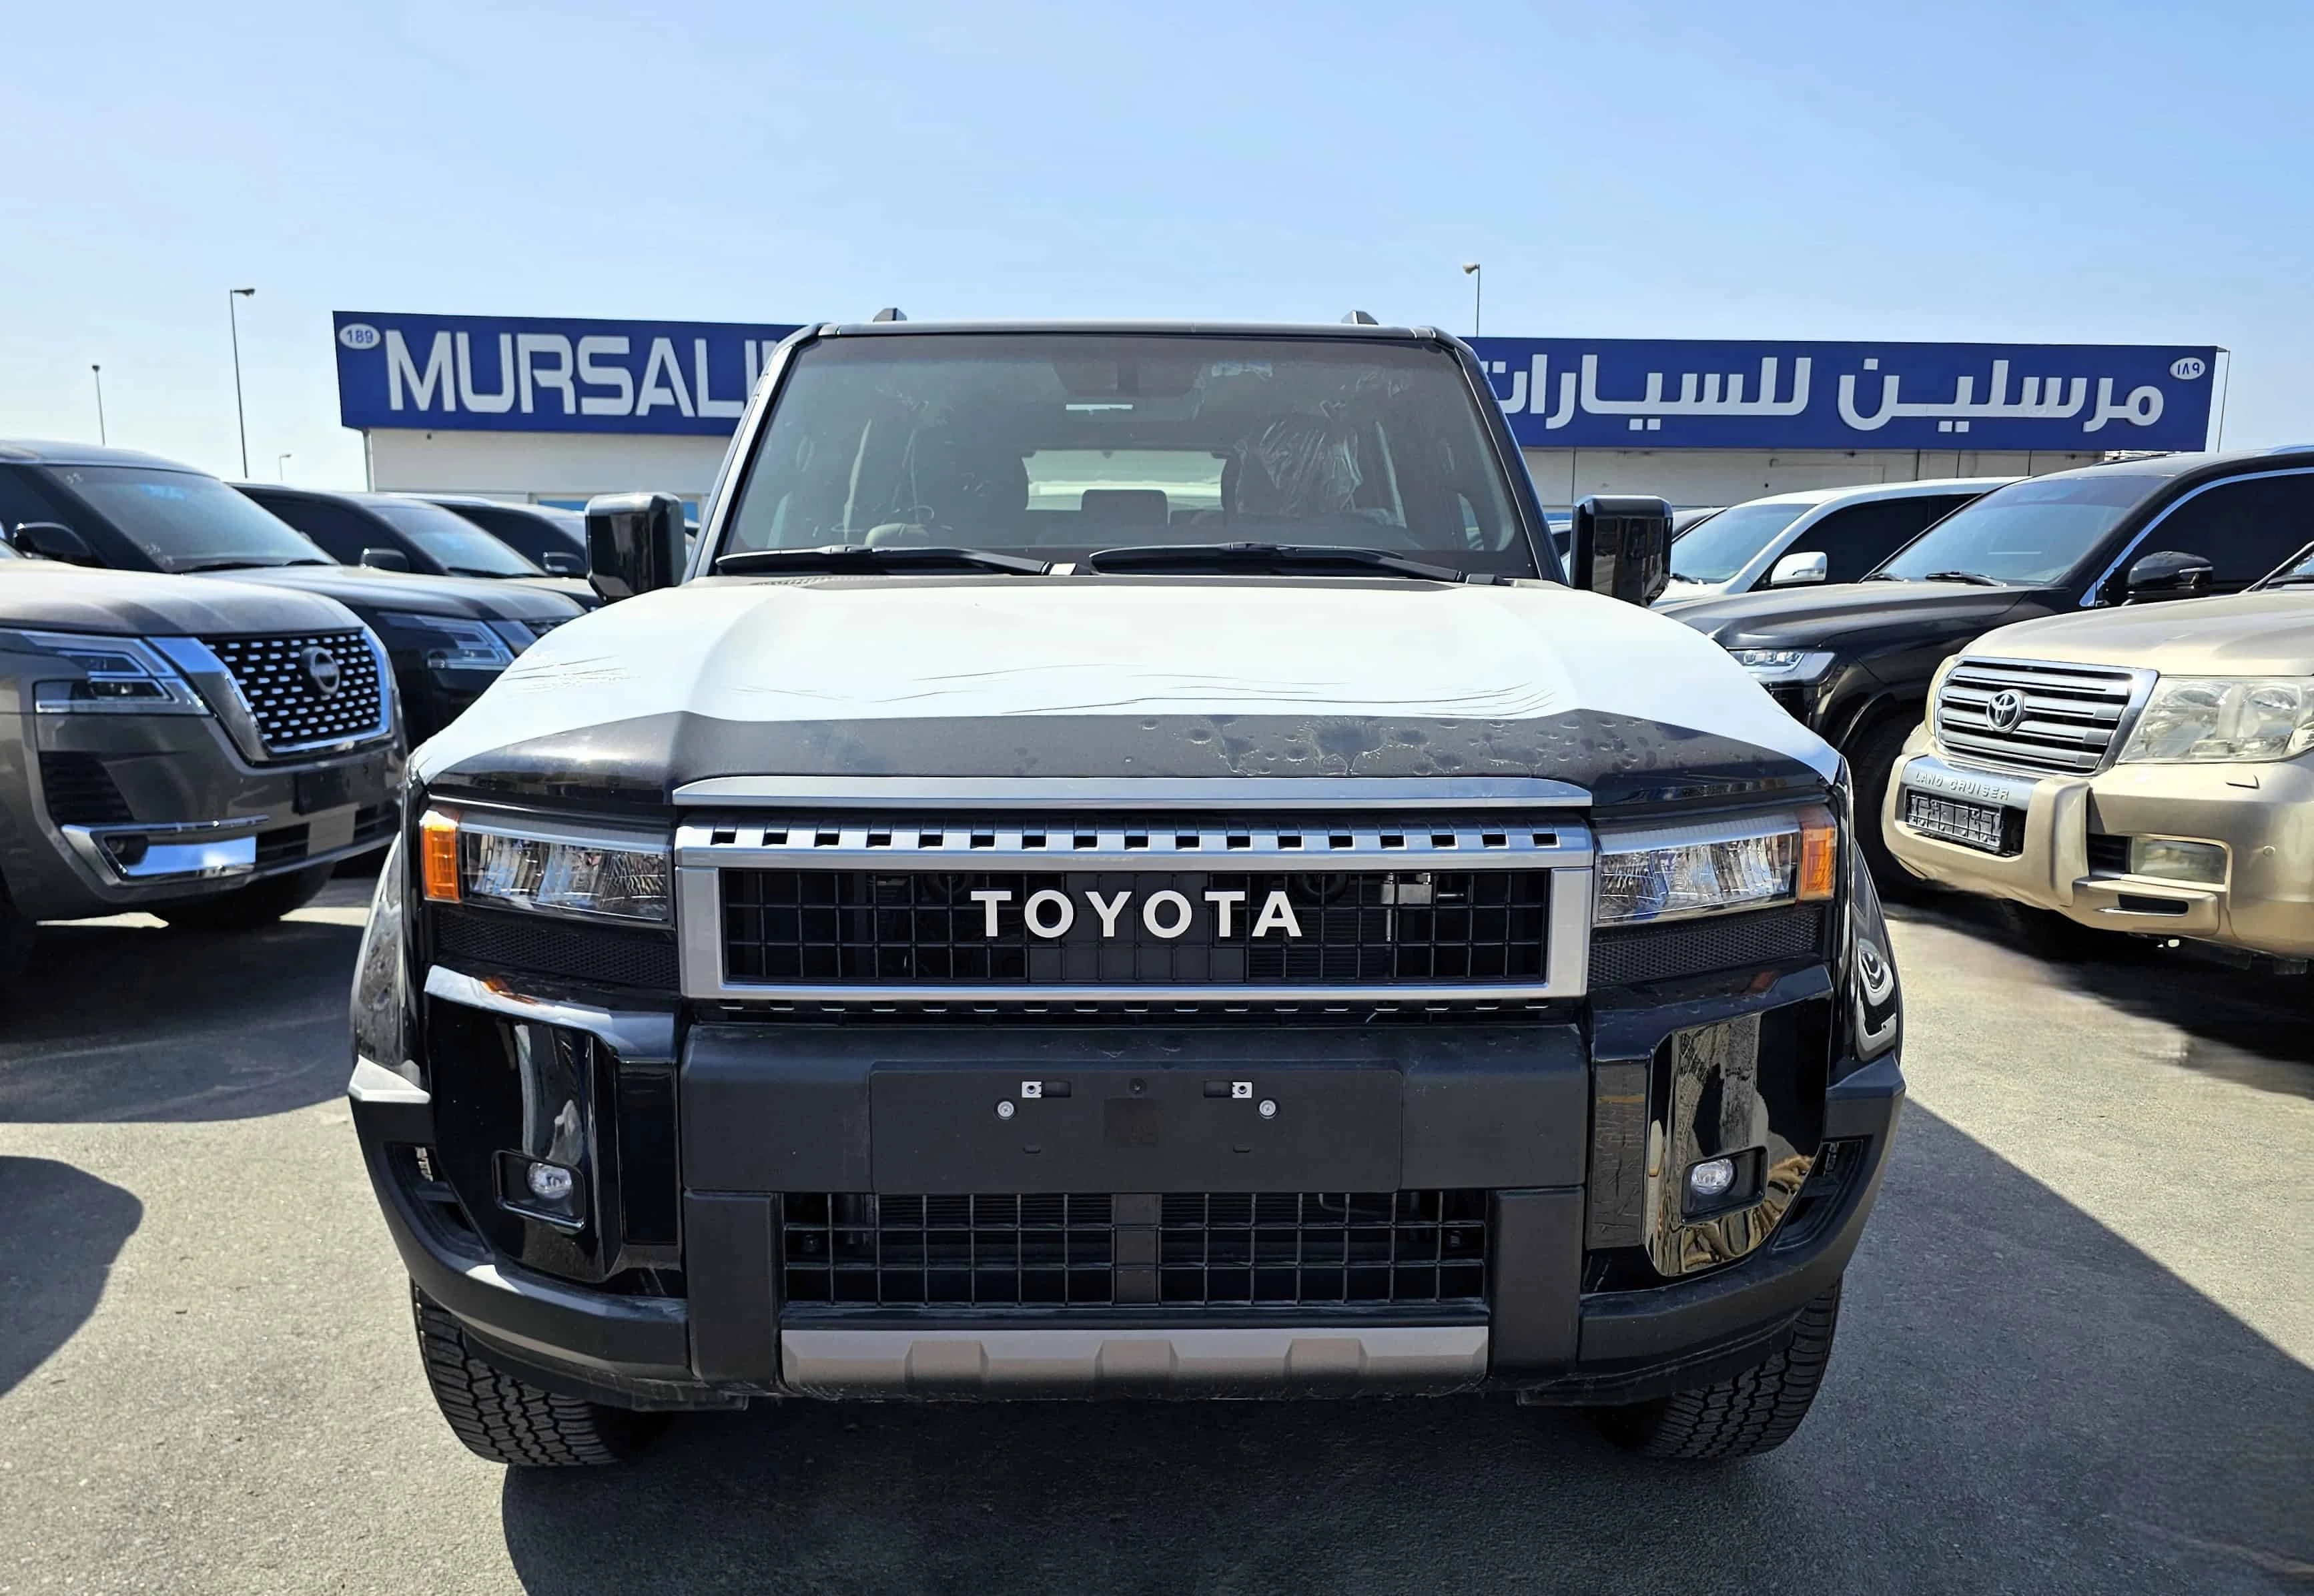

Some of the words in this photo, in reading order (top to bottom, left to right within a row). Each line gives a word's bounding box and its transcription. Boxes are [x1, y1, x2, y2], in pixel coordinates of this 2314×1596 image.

[346, 330, 374, 344] 189
[385, 329, 778, 418] MURSALI
[1838, 358, 2164, 432] مرسلين
[1916, 771, 1944, 787] LAND
[1950, 778, 2010, 801] CRUISER
[971, 890, 1302, 938] TOYOTA
